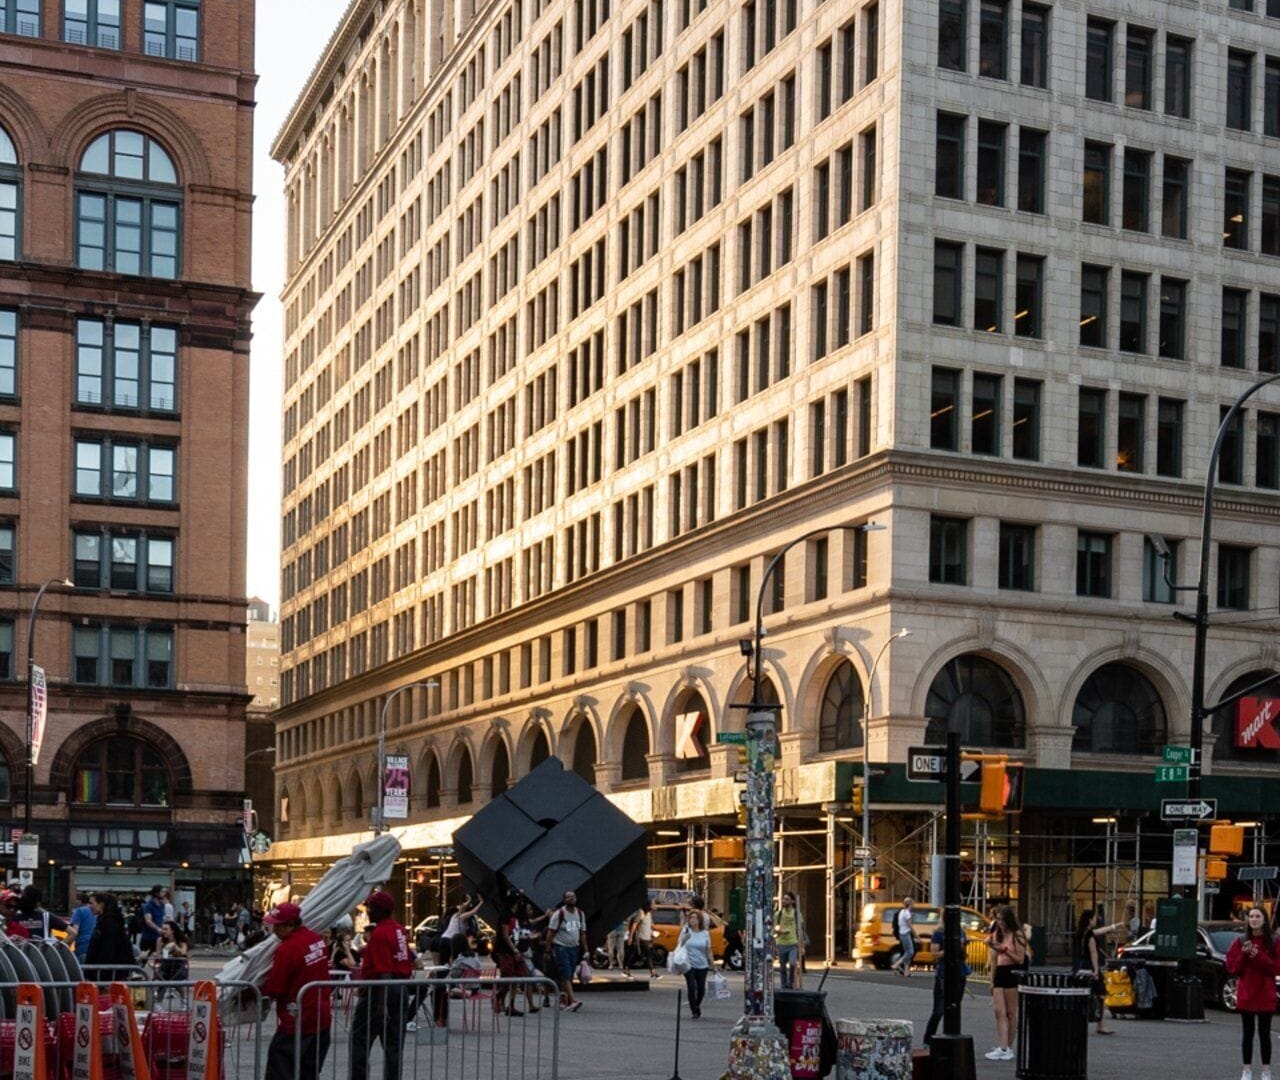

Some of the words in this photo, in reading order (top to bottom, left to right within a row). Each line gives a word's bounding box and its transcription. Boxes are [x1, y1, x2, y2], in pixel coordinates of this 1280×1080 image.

[1241, 701, 1273, 745] mart
[675, 711, 704, 759] K
[1166, 748, 1183, 761] Cooper
[915, 757, 937, 771] ONE
[385, 768, 409, 789] 25
[1162, 768, 1166, 780] E
[1169, 768, 1174, 780] 8
[386, 788, 408, 796] YEARS
[1169, 806, 1185, 814] ONE
[1191, 806, 1208, 814] WAY
[21, 1009, 32, 1024] NO
[80, 1007, 89, 1022] NO
[196, 1005, 206, 1018] NO
[18, 1055, 30, 1067] BIKE
